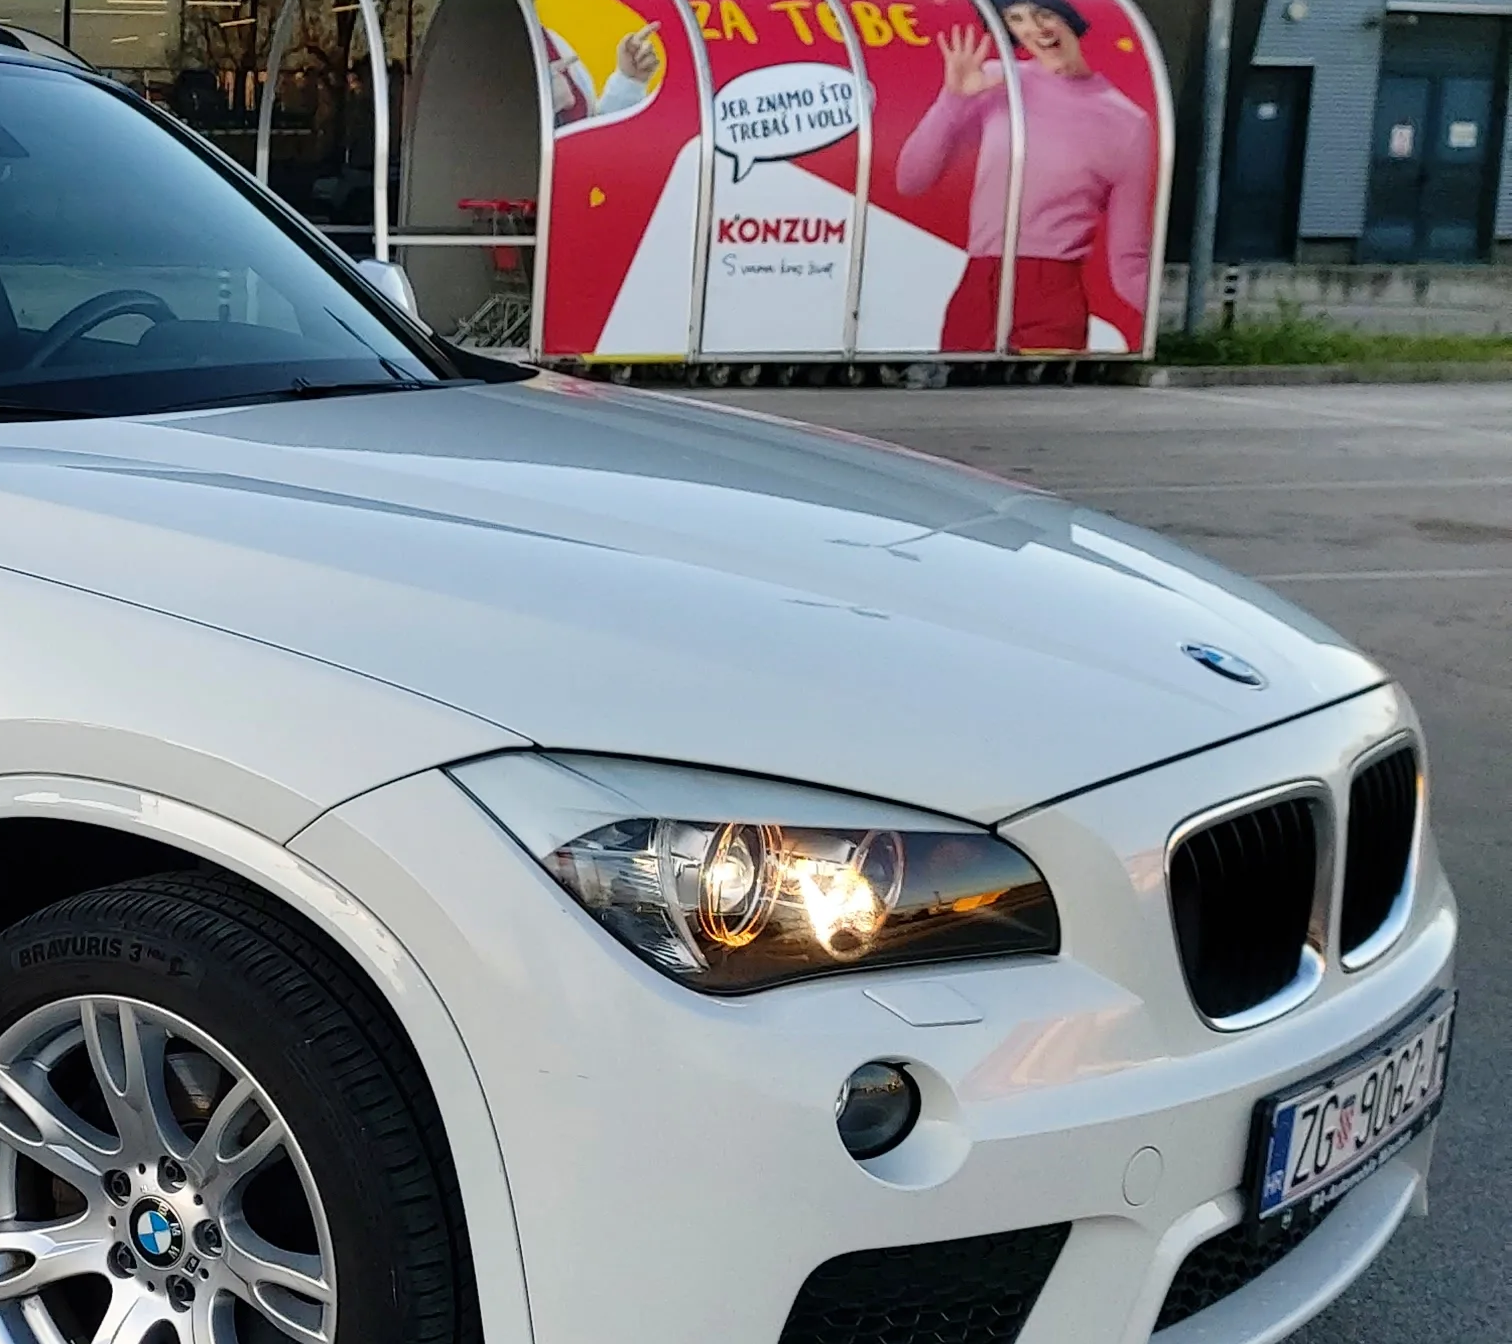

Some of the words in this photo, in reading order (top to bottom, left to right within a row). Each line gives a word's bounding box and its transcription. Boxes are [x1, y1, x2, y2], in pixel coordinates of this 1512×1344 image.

[721, 98, 750, 121] JER
[756, 88, 814, 114] ZNAMO
[820, 81, 852, 104] ŠTO
[727, 110, 790, 143] TREBAŠ
[807, 102, 853, 130] VOLIŠ
[717, 217, 847, 244] KONZUM
[18, 936, 122, 968] BRAVURIS
[1291, 1095, 1338, 1188] ZG
